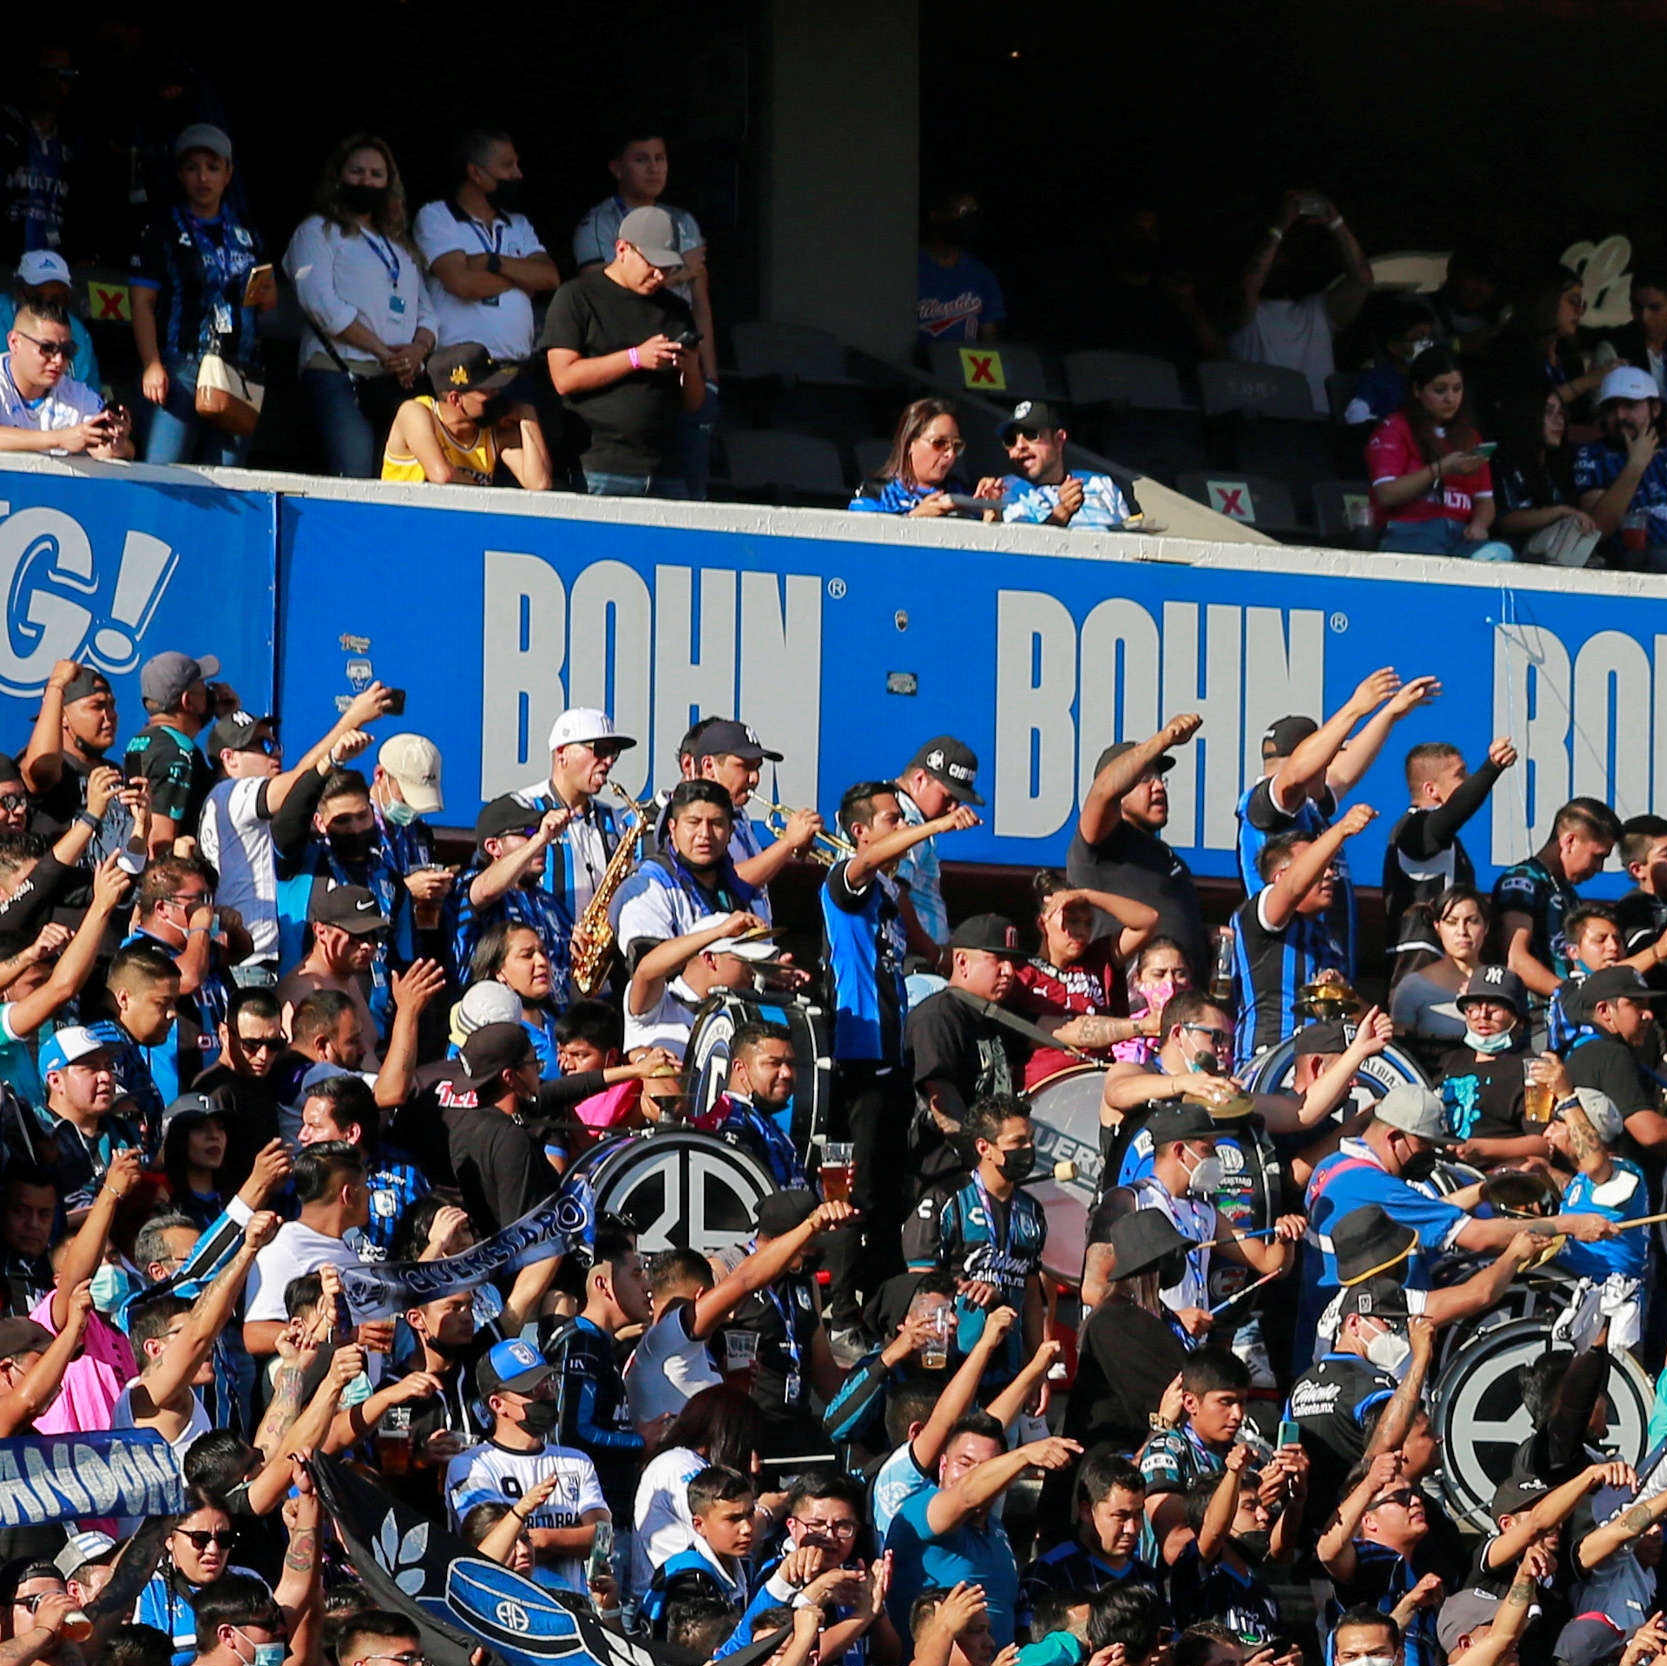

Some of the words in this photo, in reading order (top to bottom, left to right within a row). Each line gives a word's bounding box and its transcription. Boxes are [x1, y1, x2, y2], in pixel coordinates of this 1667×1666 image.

[483, 549, 822, 800] BOHN
[995, 590, 1325, 856] BOHN
[1291, 1379, 1341, 1408] Caliente
